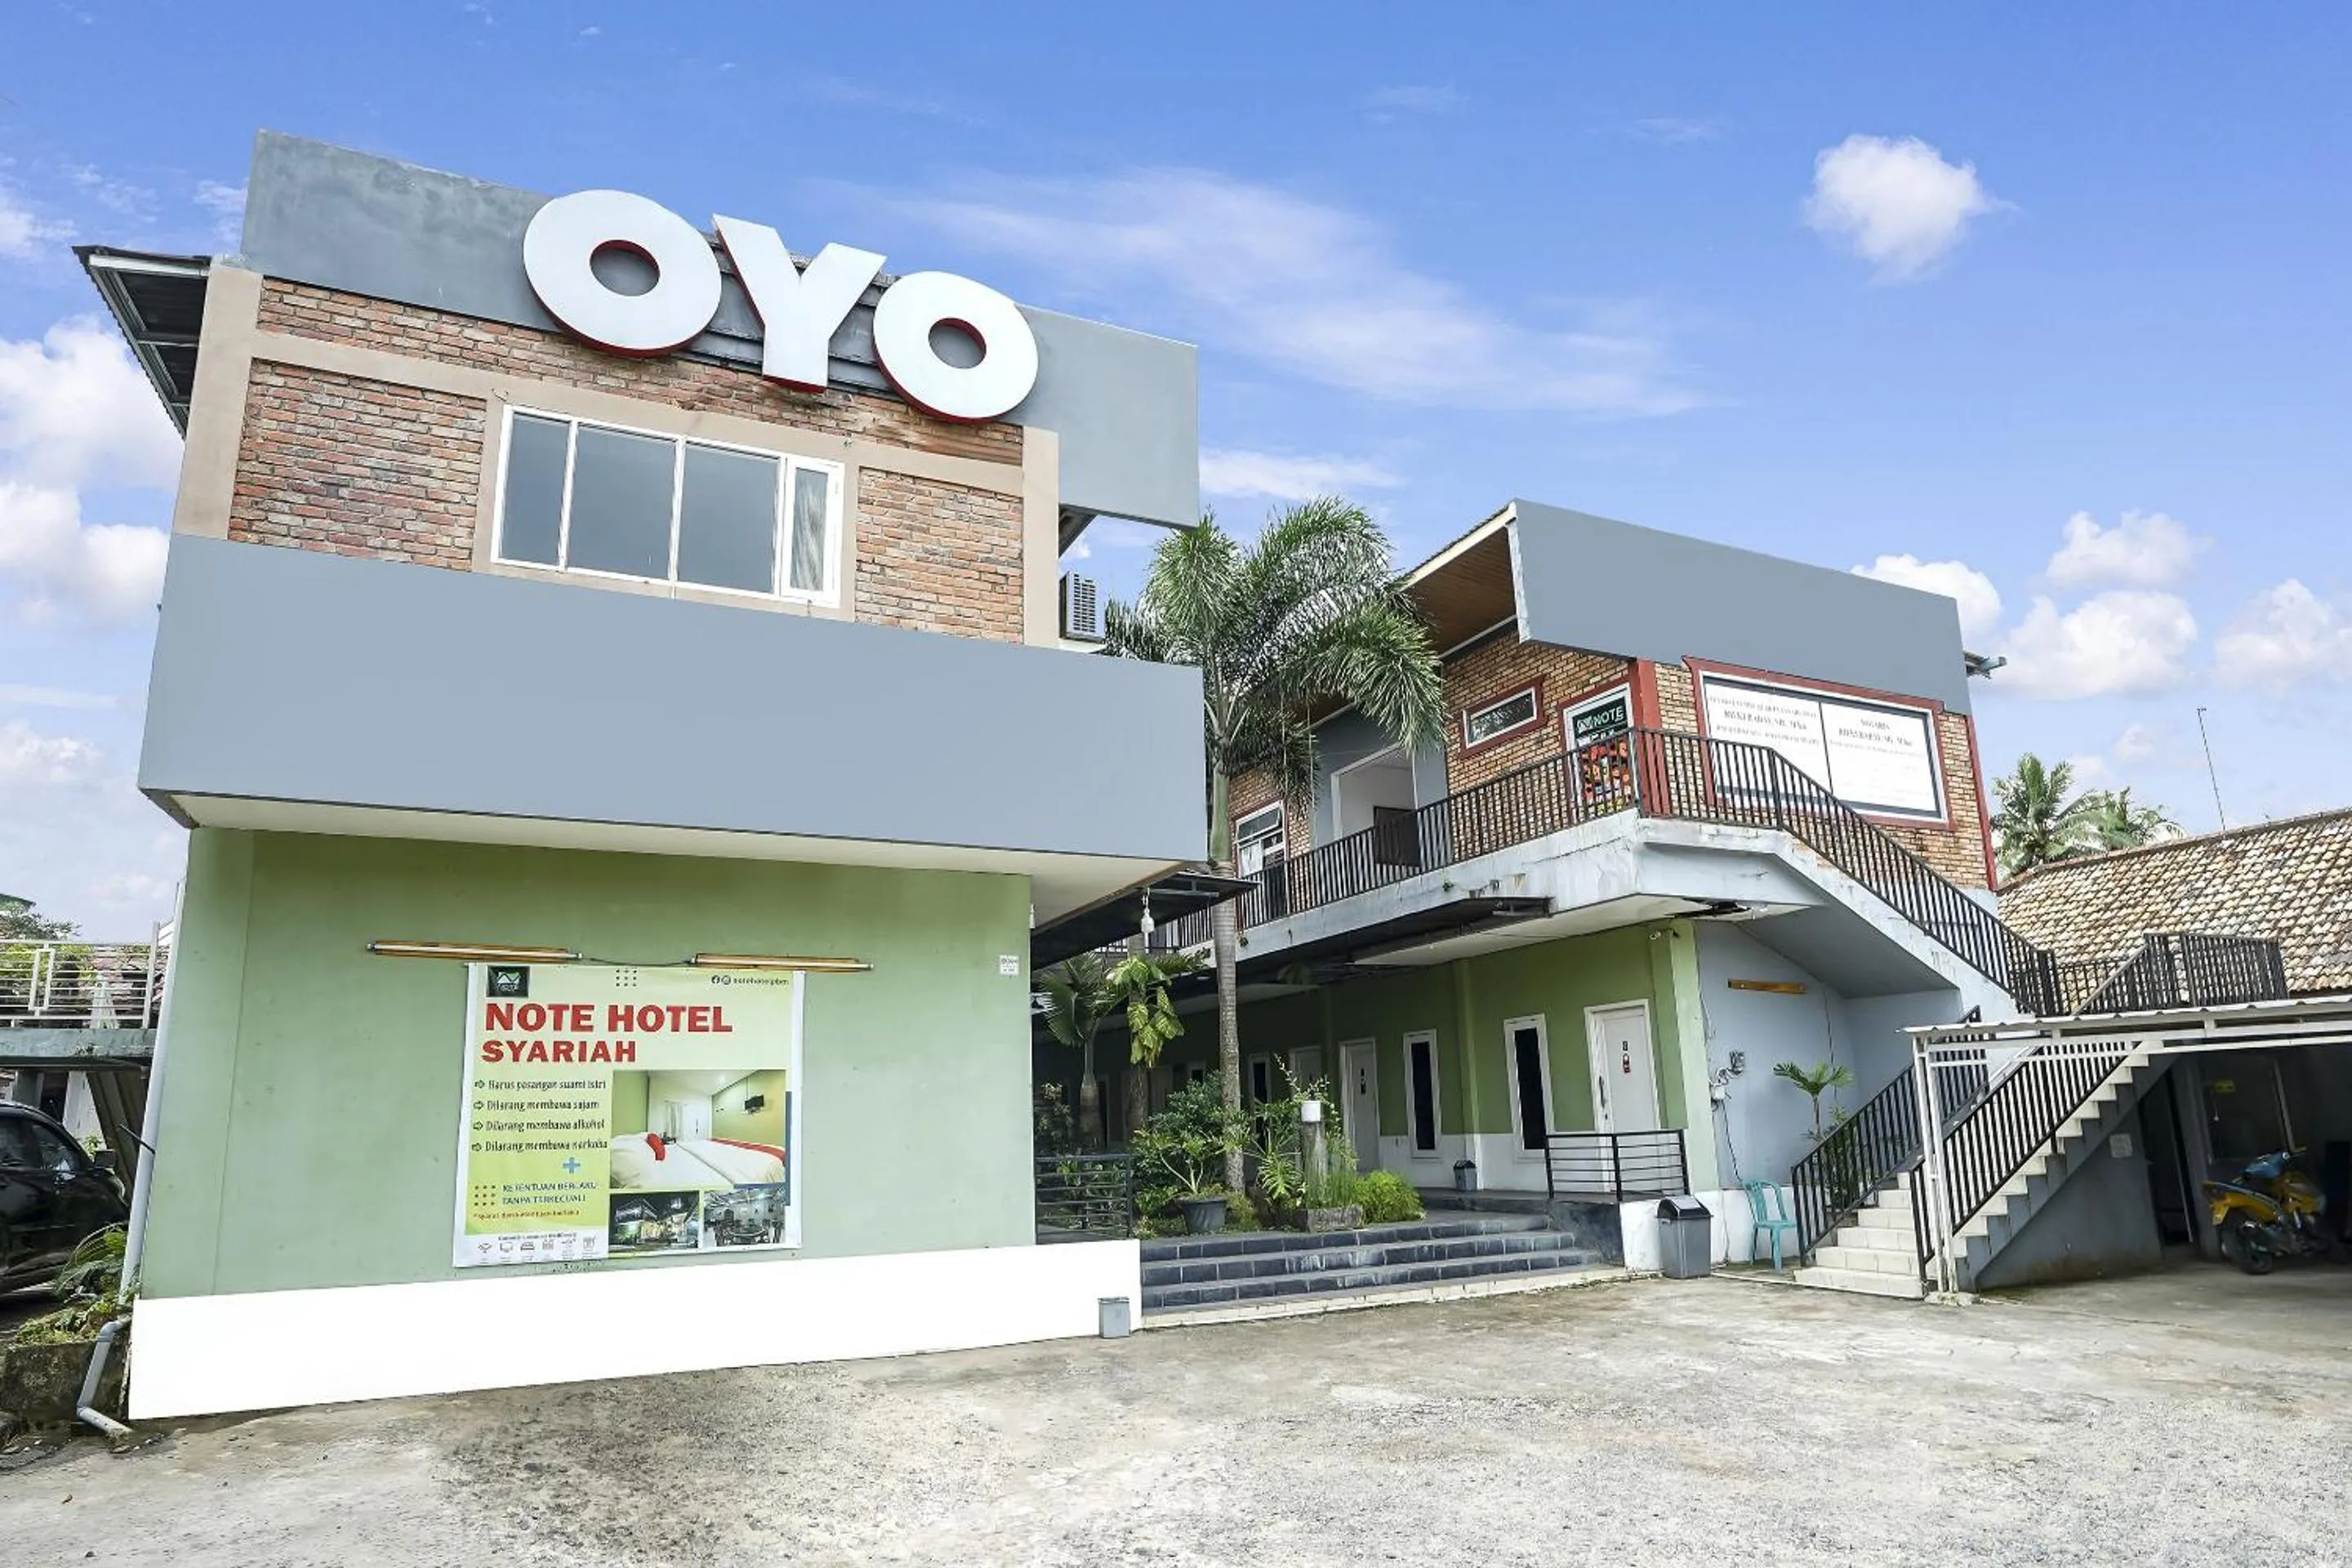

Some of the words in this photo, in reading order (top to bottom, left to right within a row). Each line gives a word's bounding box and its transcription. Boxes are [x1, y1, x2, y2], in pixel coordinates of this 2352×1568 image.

[523, 189, 1039, 423] OYO
[1593, 706, 1624, 727] NOTE
[485, 1003, 595, 1032] NOTE
[608, 1004, 733, 1033] HOTEL
[480, 1040, 636, 1062] SYARIAH
[488, 1080, 514, 1090] Harus
[517, 1082, 557, 1092] pasangan
[559, 1080, 586, 1089] suami
[587, 1079, 607, 1089] istri
[487, 1100, 526, 1111] Dilarang
[527, 1099, 571, 1110] membawa
[573, 1100, 599, 1111] sajam
[486, 1120, 524, 1132] Dilarang
[526, 1119, 571, 1129] membawa
[573, 1118, 604, 1129] alkohol
[485, 1141, 523, 1152] Dilarang
[525, 1139, 570, 1150] membawa
[502, 1196, 532, 1205] TANPA
